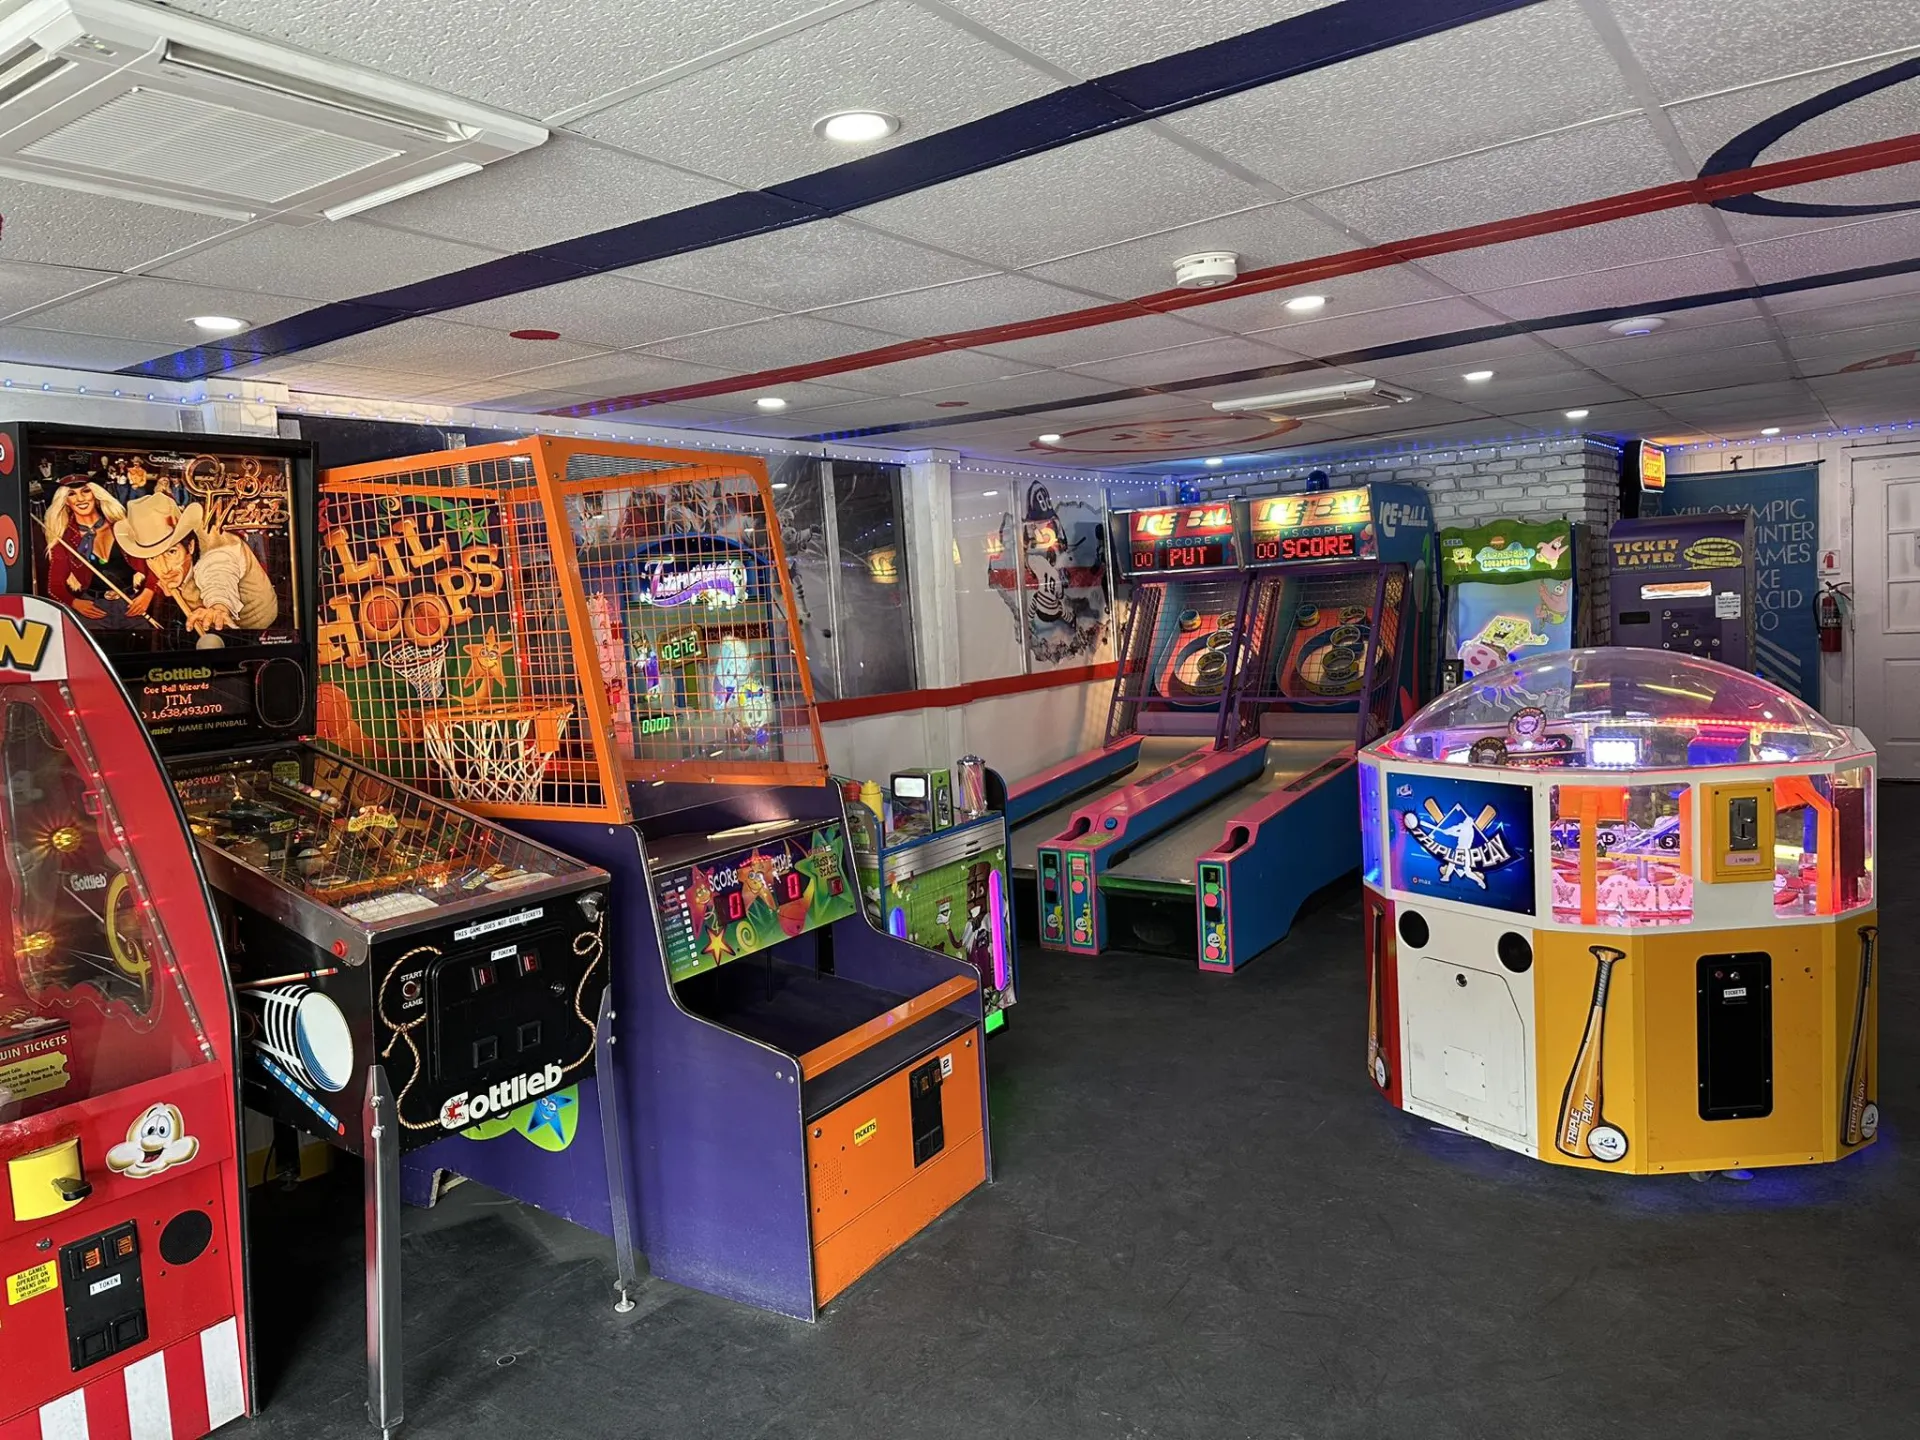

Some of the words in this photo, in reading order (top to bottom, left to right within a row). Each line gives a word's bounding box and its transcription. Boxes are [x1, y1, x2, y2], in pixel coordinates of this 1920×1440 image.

[1258, 499, 1303, 526] ICE
[1136, 512, 1178, 536] ICE
[1291, 525, 1344, 537] SCORE
[1755, 521, 1815, 544] INTER
[1166, 536, 1212, 548] SCORE
[1282, 534, 1354, 559] SCORE
[1613, 540, 1679, 554] TICKET
[1169, 546, 1208, 567] PUT
[1256, 543, 1278, 559] 00
[1617, 552, 1677, 566] EATER
[1755, 543, 1811, 566] AMES
[1756, 569, 1781, 590] KE
[318, 545, 504, 669] HOOPS
[1755, 589, 1803, 610] ACID
[148, 666, 212, 682] Gottlieb
[164, 693, 193, 710] JTM
[151, 703, 223, 720] 1,638,493,070
[150, 726, 174, 736] mier
[177, 722, 204, 733] NAME
[204, 721, 215, 730] IN
[215, 719, 249, 729] PINBALL
[1602, 834, 1614, 843] 15
[1665, 837, 1674, 847] 5
[1411, 827, 1466, 866] TRIPLE
[1469, 833, 1512, 868] PLAY
[70, 874, 107, 891] Gottlieb
[708, 867, 740, 892] SCORE
[455, 929, 468, 938] THIS
[469, 925, 482, 934] GAME
[483, 923, 496, 931] DOES
[508, 916, 520, 924] GIVE
[522, 910, 542, 921] TICKETS
[498, 947, 515, 956] TOKENS
[400, 969, 424, 983] START
[402, 996, 424, 1010] GAME
[24, 1034, 68, 1054] TICKETS
[942, 1058, 950, 1069] 2
[440, 1061, 564, 1130] Gottlieb
[1581, 1094, 1595, 1125] PLAY
[854, 1122, 877, 1141] TICKETS
[1566, 1108, 1582, 1147] TRIPLE
[17, 1271, 27, 1280] ALL
[28, 1265, 47, 1276] GAMES
[15, 1282, 37, 1294] TOKENS
[37, 1276, 51, 1285] ONLY
[16, 1276, 39, 1287] OPERATE
[99, 1278, 119, 1289] TOKEN
